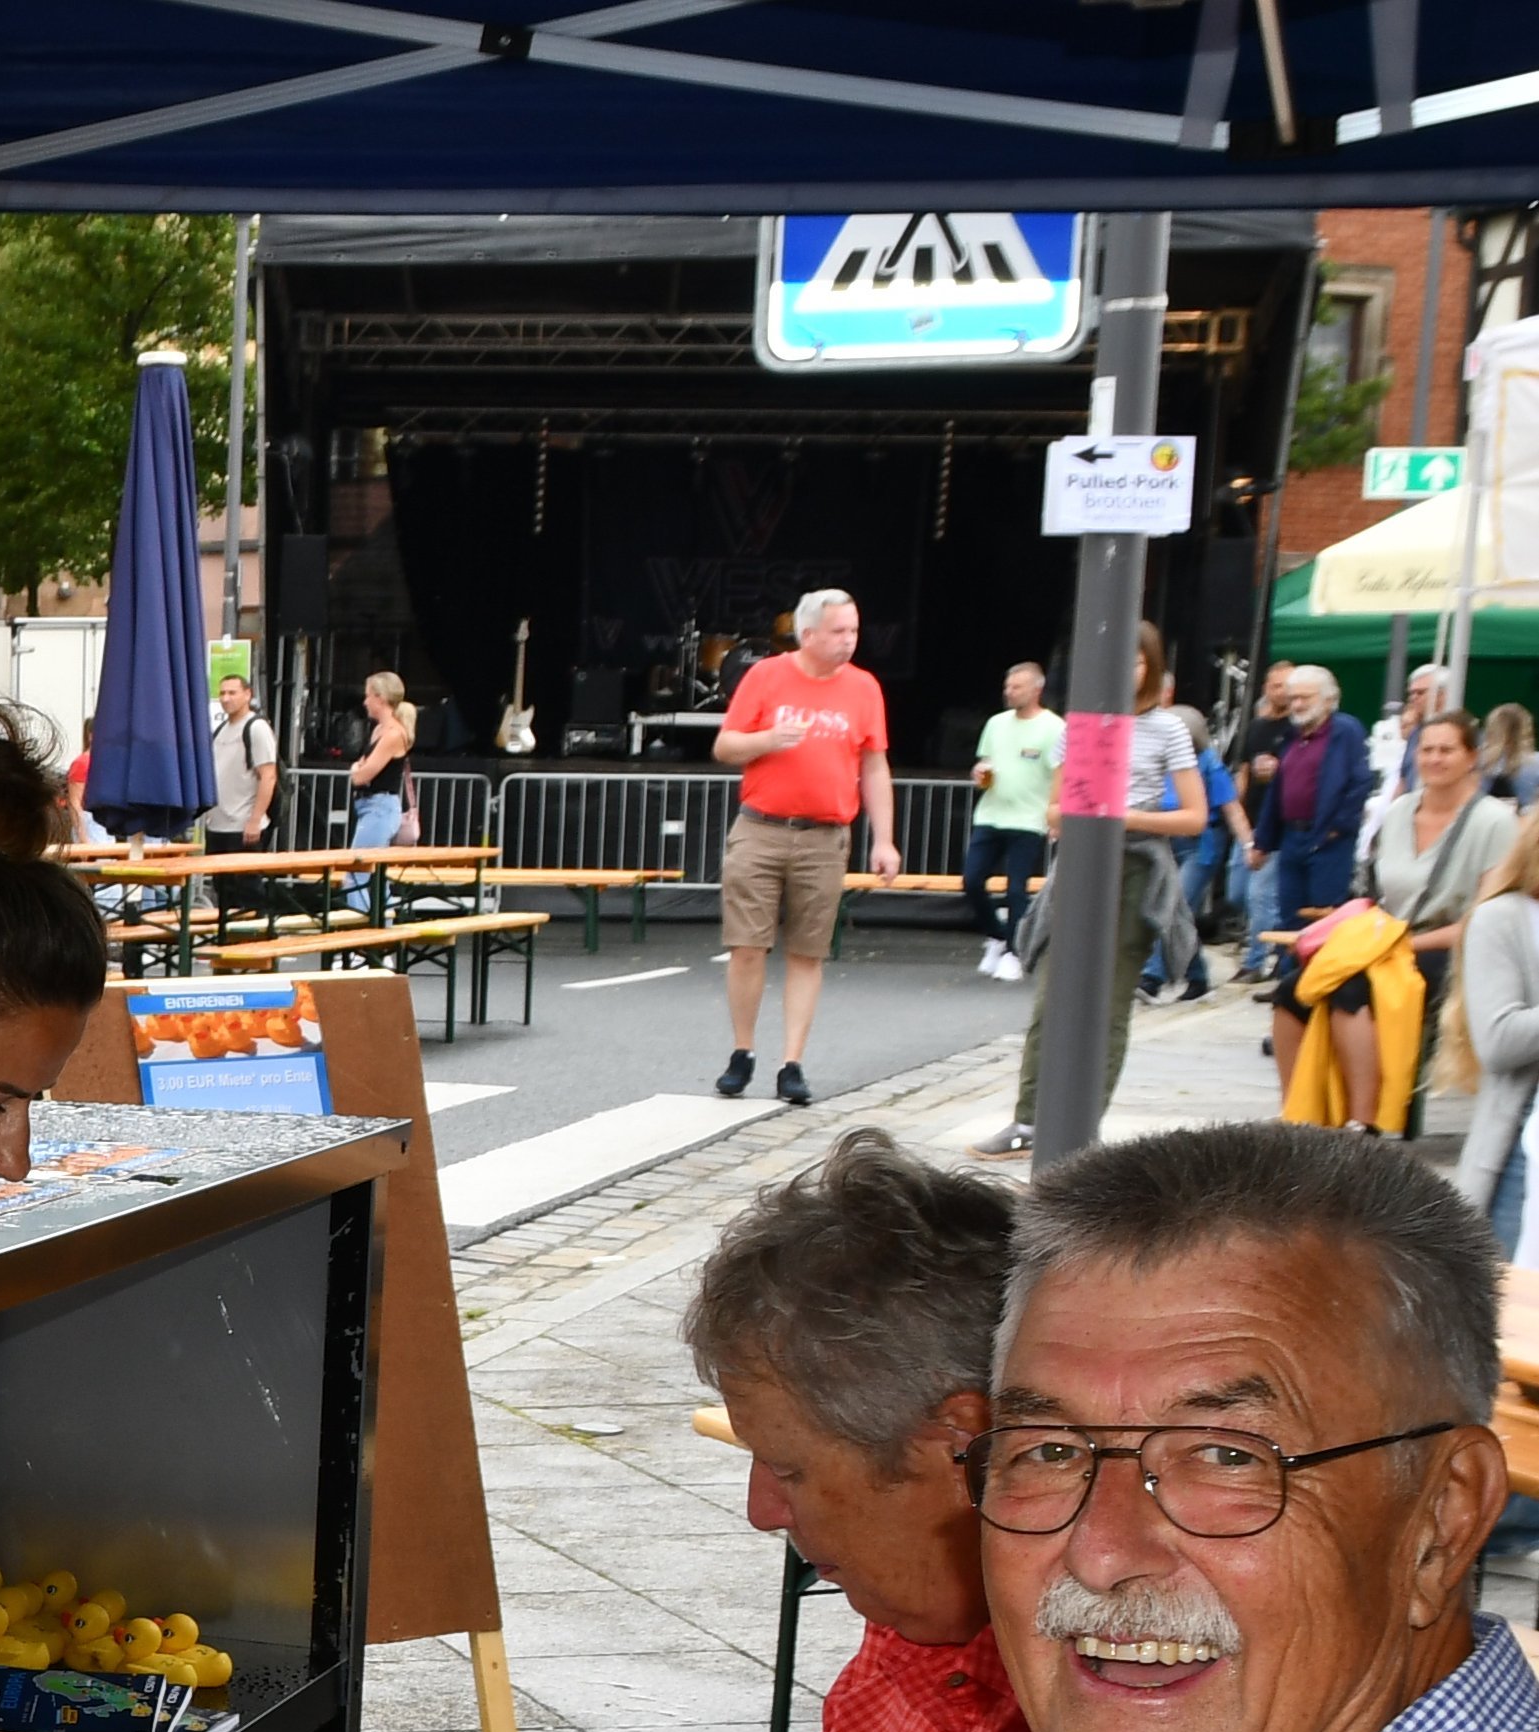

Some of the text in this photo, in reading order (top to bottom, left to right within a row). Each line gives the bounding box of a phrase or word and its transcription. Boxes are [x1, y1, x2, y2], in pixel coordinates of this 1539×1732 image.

[165, 994, 244, 1010] ENTENRENNEN
[158, 1075, 183, 1091] 3,00
[187, 1074, 215, 1088] EUR
[261, 1073, 281, 1086] pro
[285, 1069, 313, 1084] Ente
